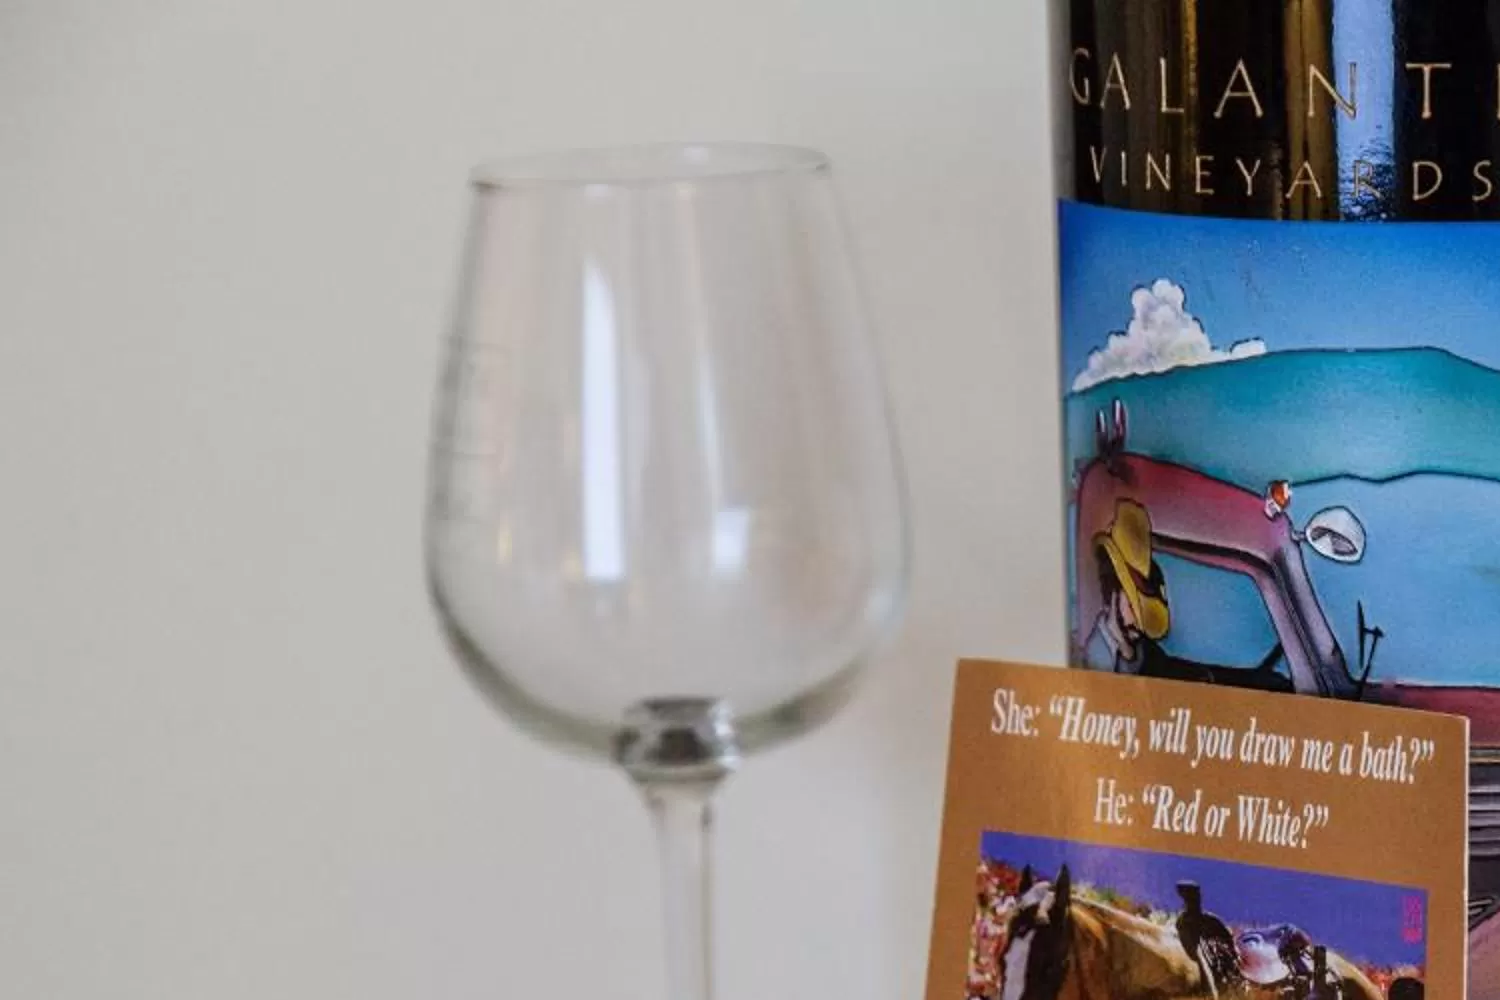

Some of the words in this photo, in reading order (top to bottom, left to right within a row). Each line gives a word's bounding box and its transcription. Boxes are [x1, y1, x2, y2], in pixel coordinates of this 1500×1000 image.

[1090, 145, 1494, 202] VINEYARDS
[991, 688, 1040, 737] She:
[1149, 708, 1191, 754] will
[1190, 722, 1235, 769] you
[1239, 716, 1296, 768] draw
[1300, 738, 1334, 773] me
[1338, 743, 1354, 776] a
[1093, 777, 1135, 827] He:
[1204, 802, 1231, 838] or
